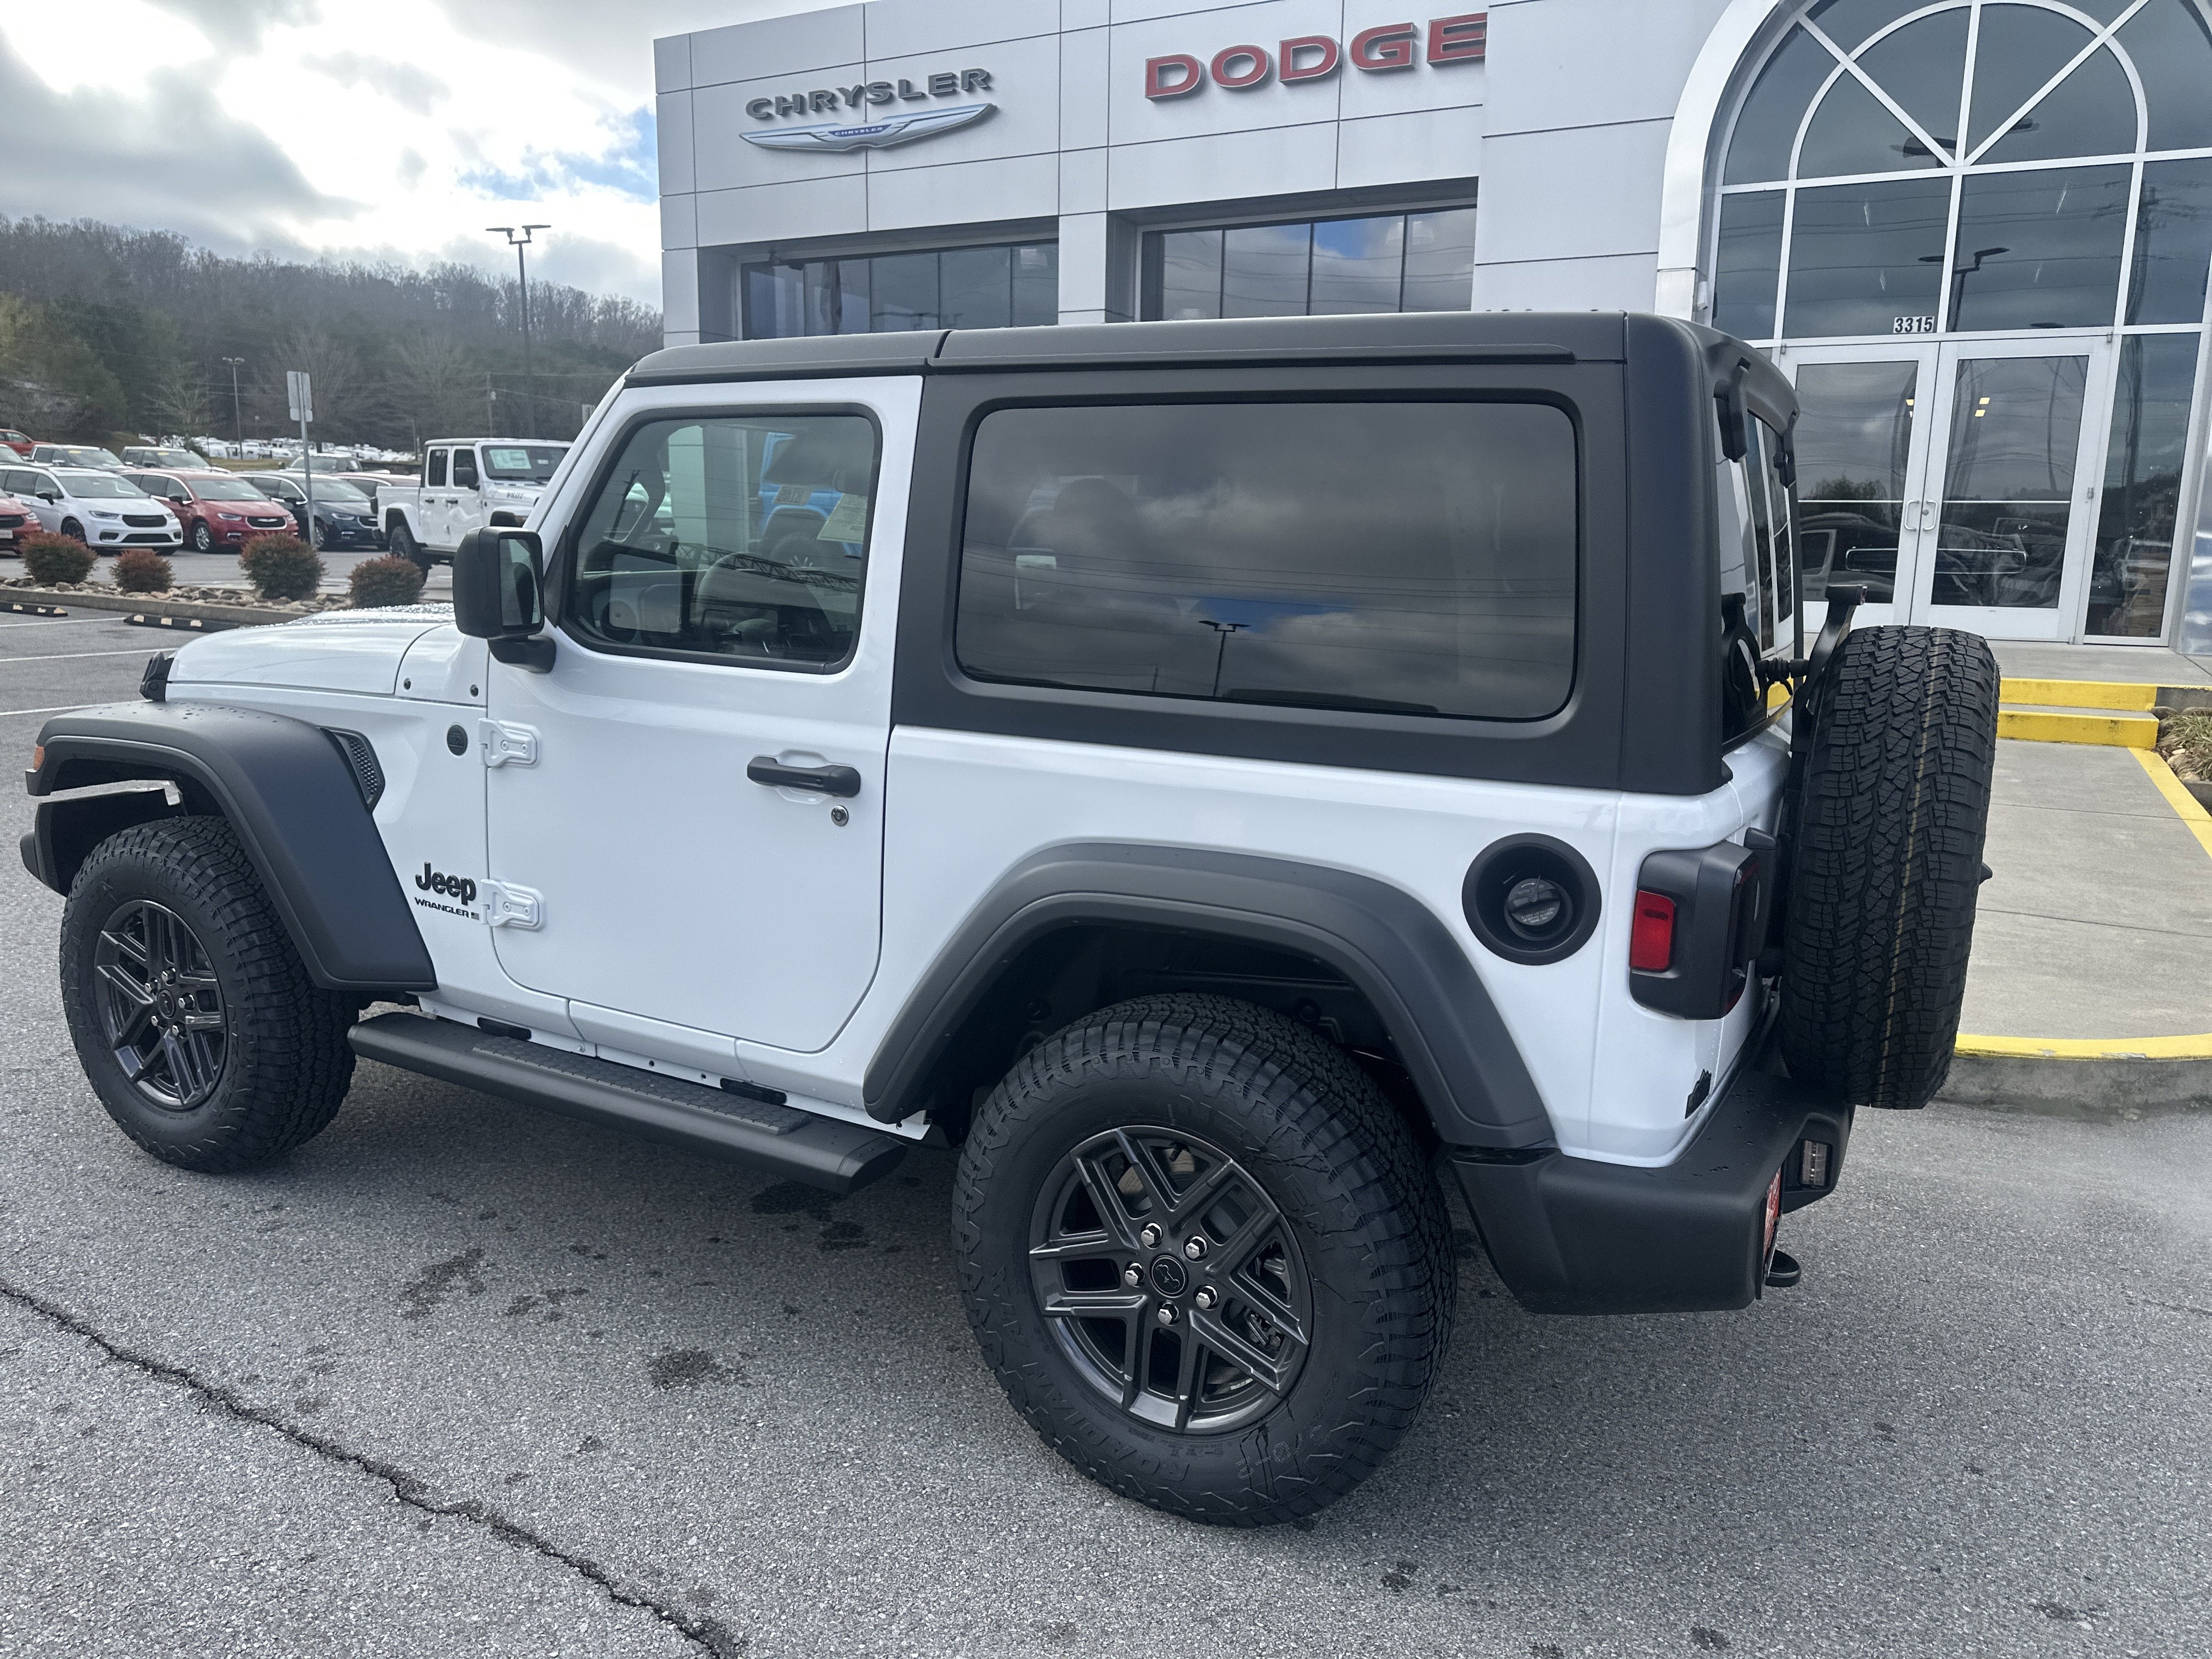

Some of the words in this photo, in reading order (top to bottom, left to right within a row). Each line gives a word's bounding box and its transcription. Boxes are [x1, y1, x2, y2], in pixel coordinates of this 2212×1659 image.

[1145, 13, 1487, 101] DODGE
[745, 68, 992, 120] CHRYSLER
[834, 127, 883, 136] CHRYSLER
[1894, 317, 1934, 333] 3315
[415, 861, 477, 906] Jeep
[414, 896, 470, 918] WRANGLER
